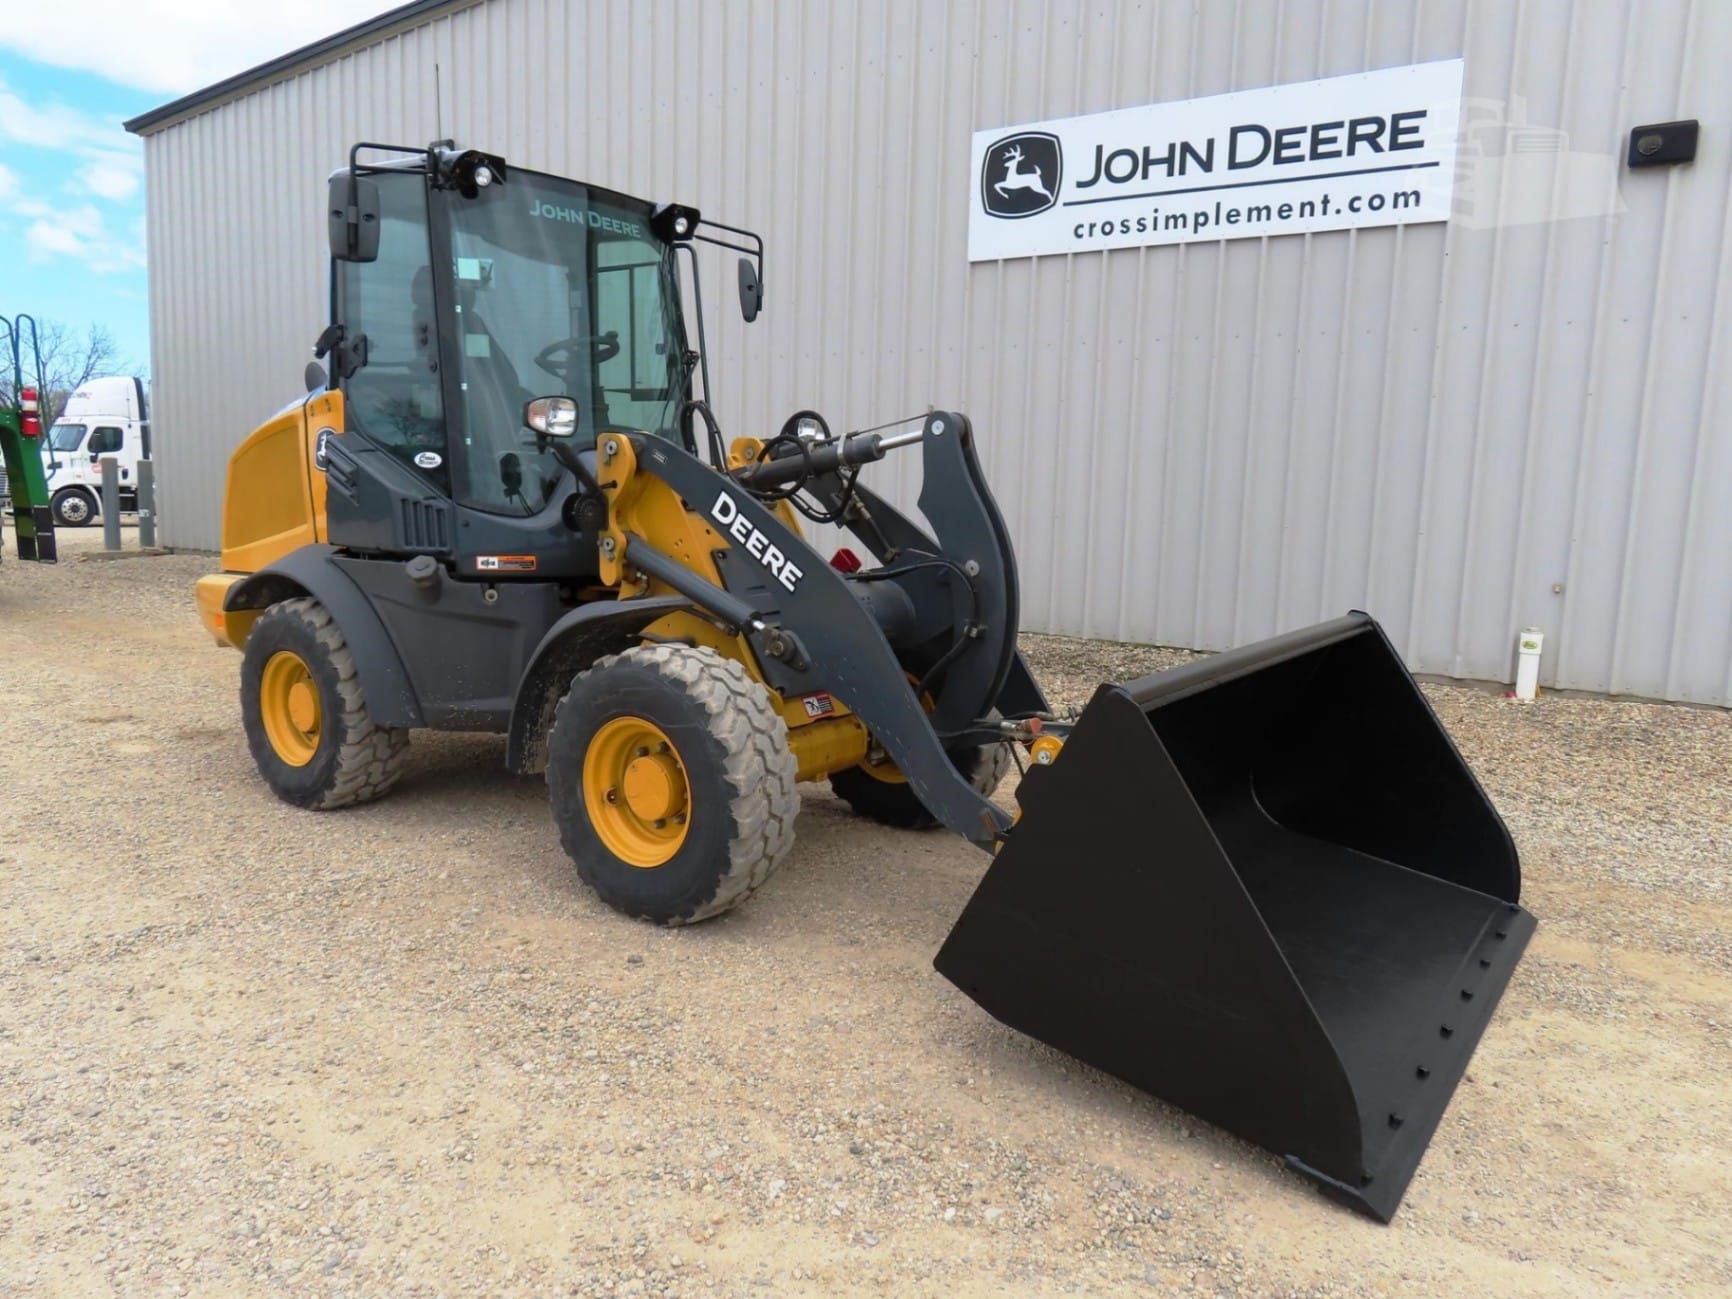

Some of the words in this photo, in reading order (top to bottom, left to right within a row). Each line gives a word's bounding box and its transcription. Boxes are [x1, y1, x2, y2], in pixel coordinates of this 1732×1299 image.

[1076, 138, 1215, 188] JOHN
[1228, 110, 1427, 170] DEERE
[529, 200, 584, 225] JOHN
[588, 211, 640, 238] DEERE
[1074, 190, 1421, 238] crossimplement.com
[711, 491, 803, 592] DEERE
